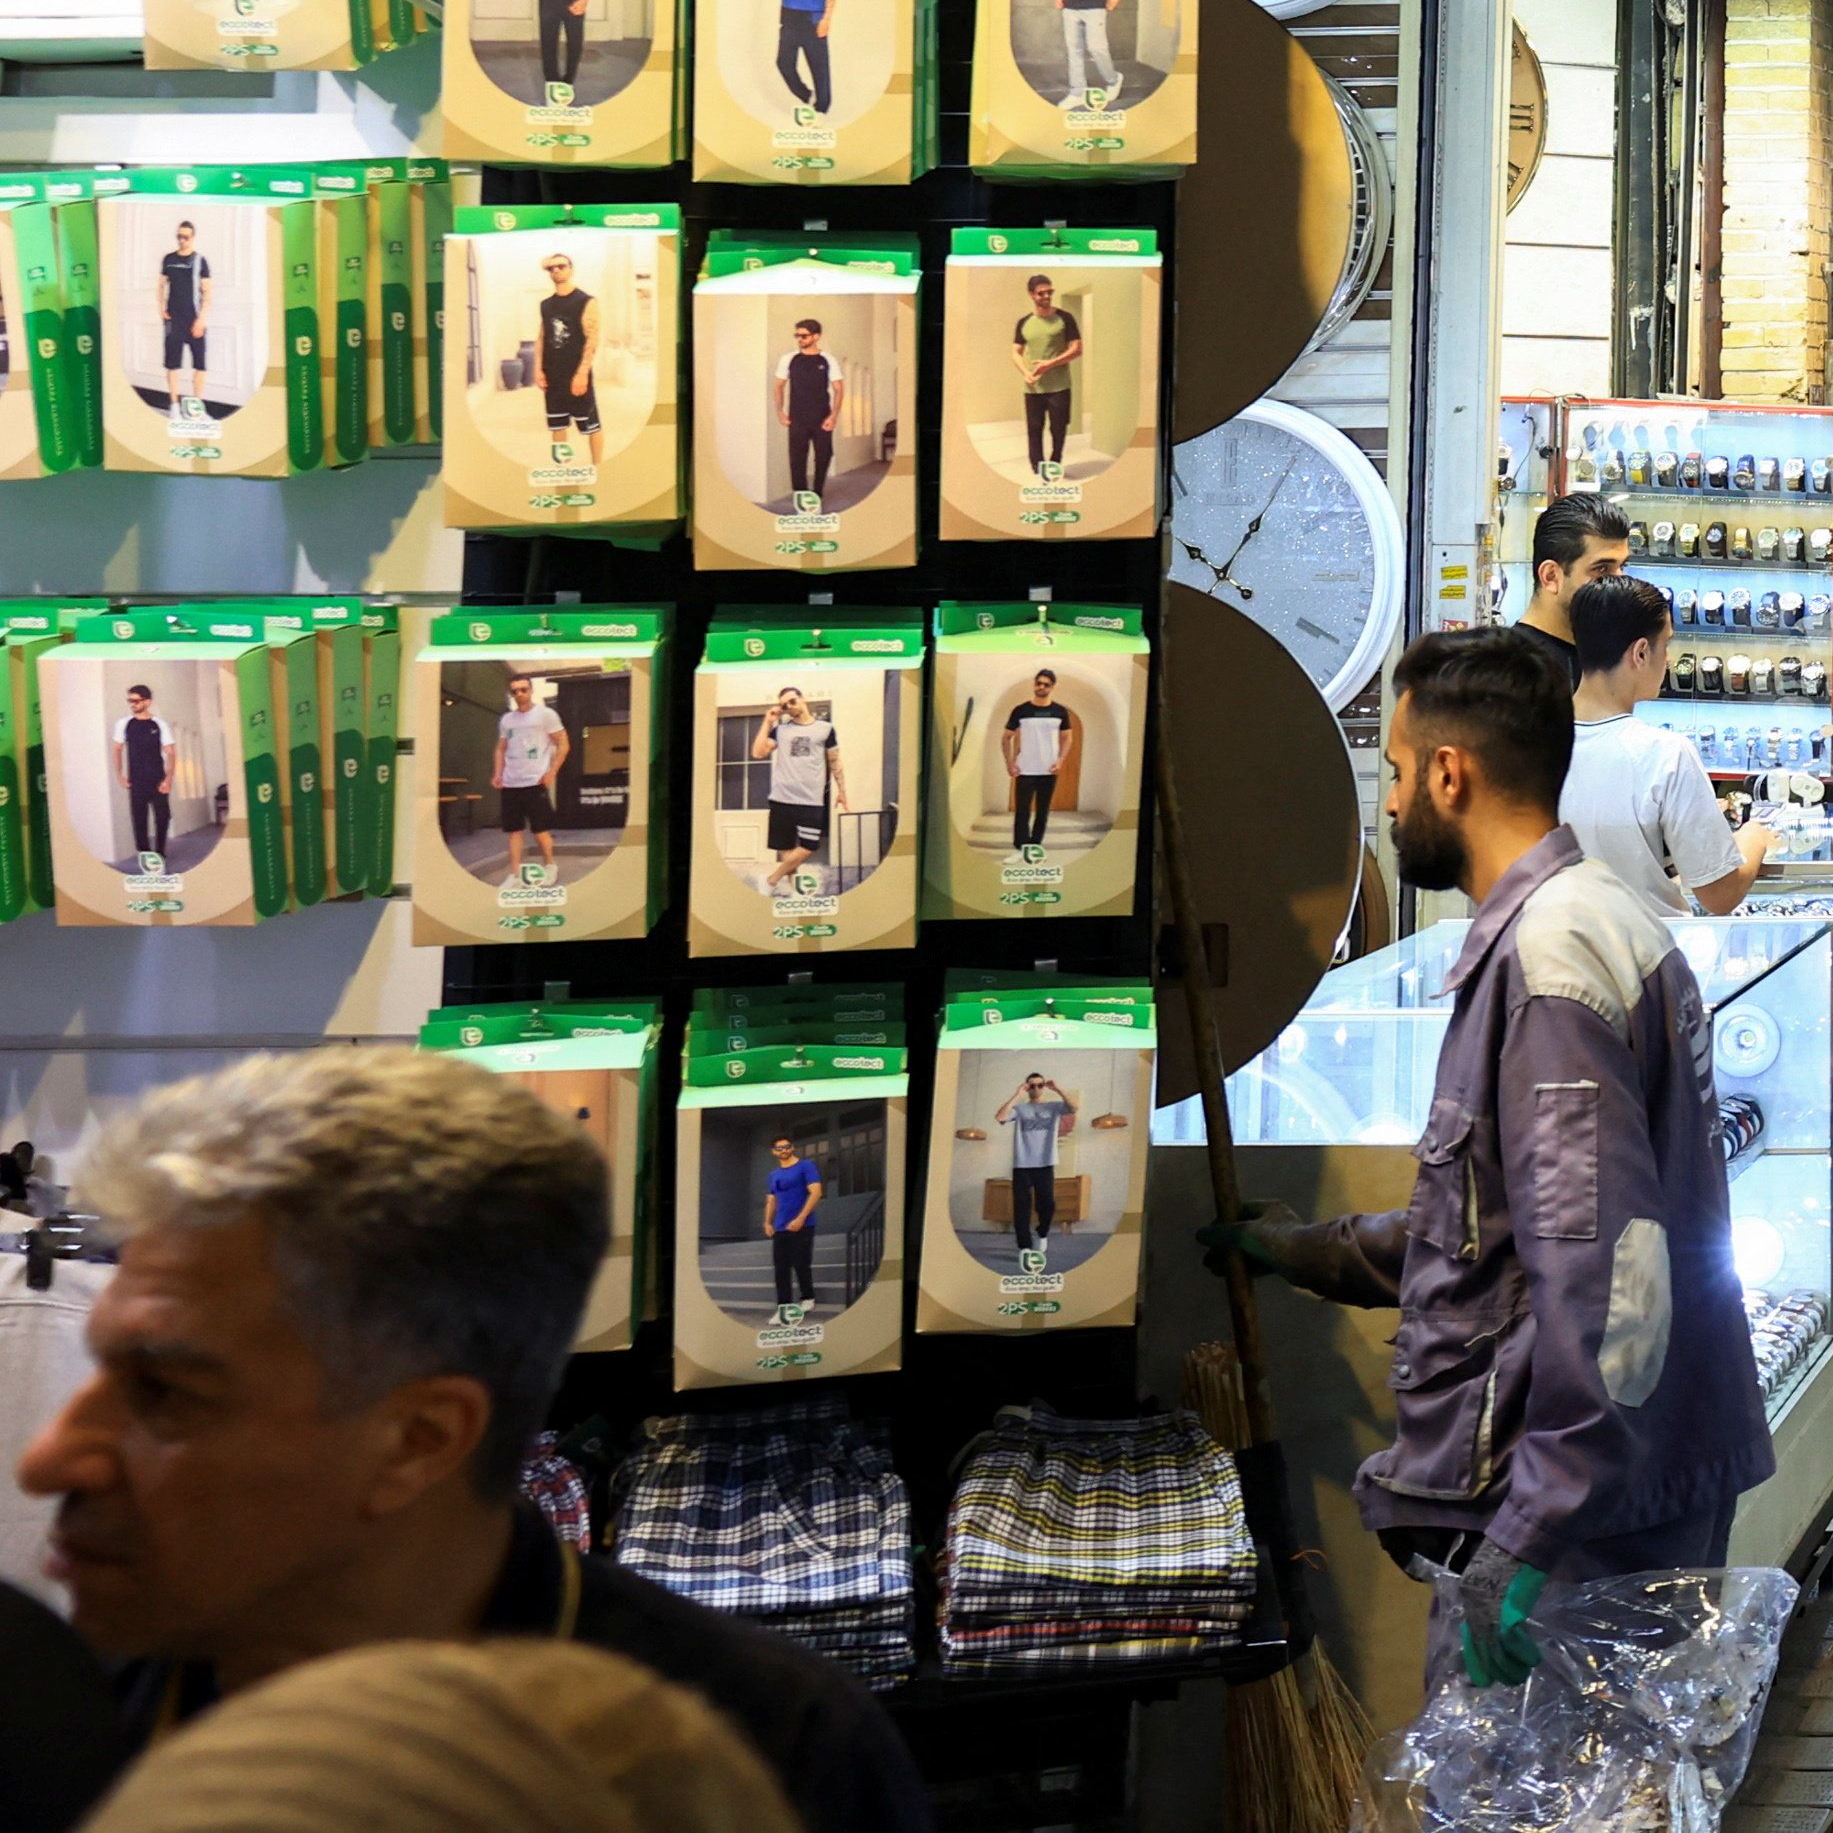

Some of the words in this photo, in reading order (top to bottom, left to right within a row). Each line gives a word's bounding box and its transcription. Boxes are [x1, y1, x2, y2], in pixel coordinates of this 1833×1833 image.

[1003, 867, 1063, 878] eccotect
[500, 889, 565, 900] eccotect
[1001, 1275, 1063, 1288] eccotect
[758, 1328, 824, 1342] eccotect
